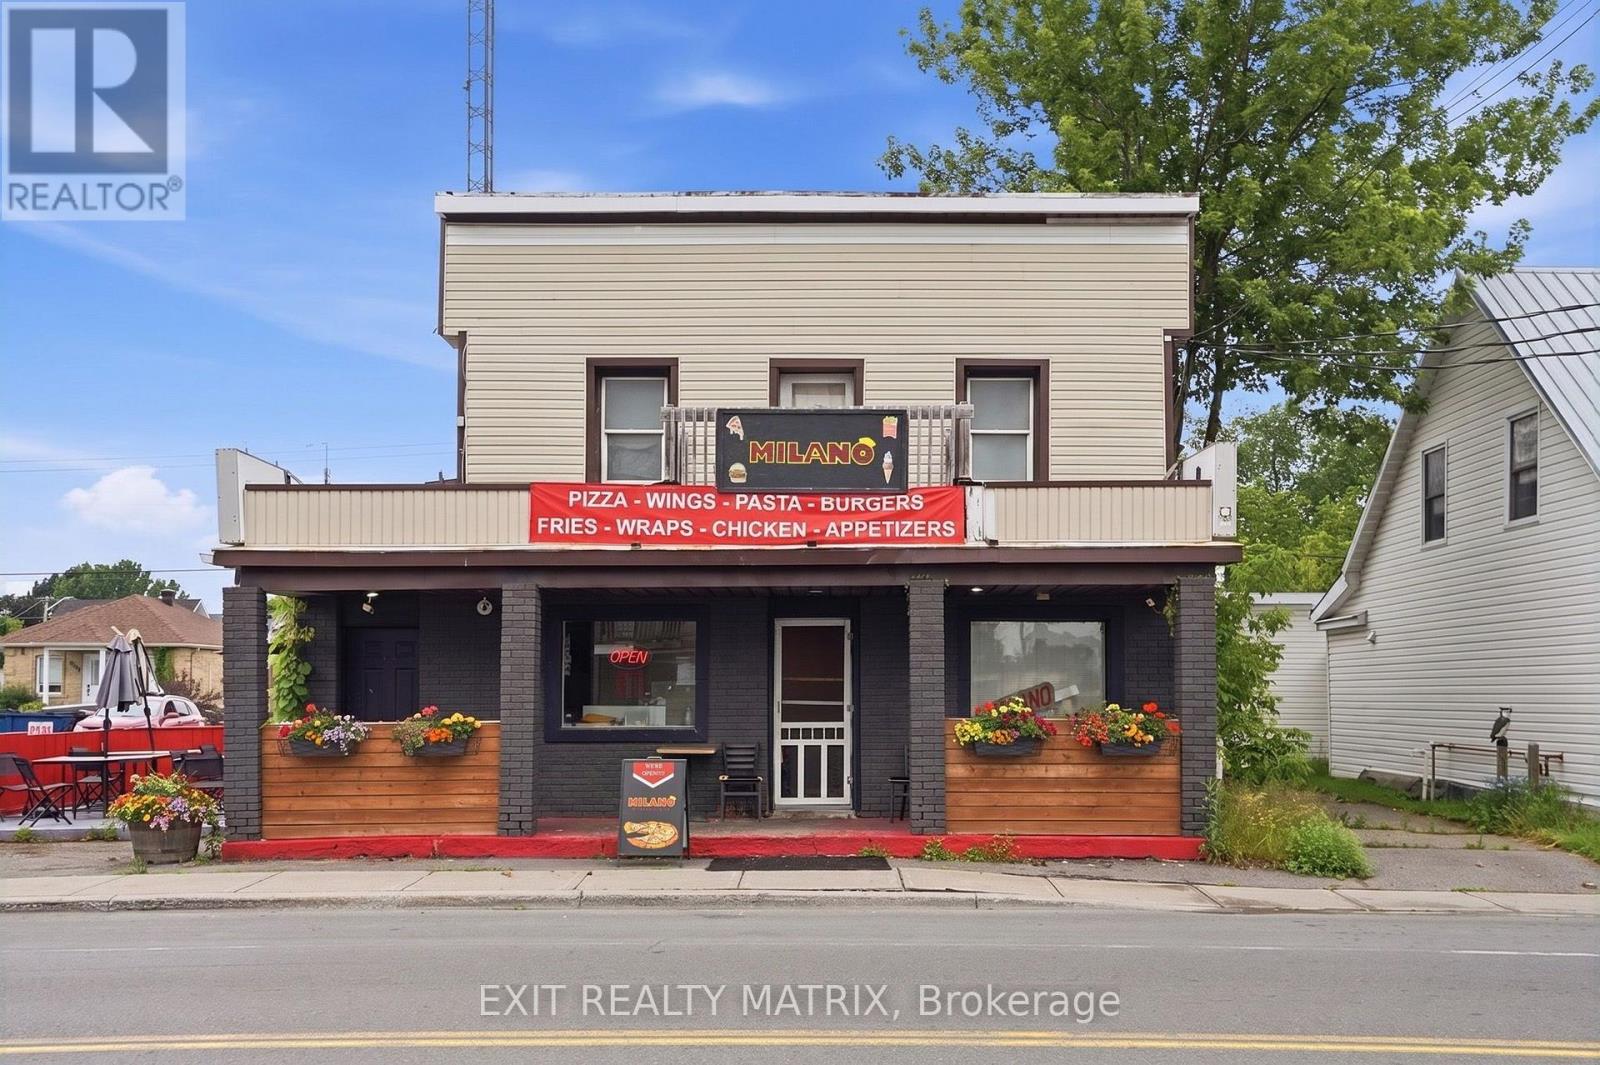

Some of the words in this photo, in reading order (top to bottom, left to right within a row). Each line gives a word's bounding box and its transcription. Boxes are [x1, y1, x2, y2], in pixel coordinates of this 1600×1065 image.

[749, 440, 875, 466] MILANO
[568, 491, 628, 508] PIZZA
[645, 492, 716, 510] WINGS
[735, 494, 802, 511] PASTA
[820, 494, 924, 512] BURGERS
[537, 518, 598, 535] FRIES
[616, 519, 694, 537] WRAPS
[712, 520, 806, 538] CHICKEN
[825, 520, 956, 538] APPETIZERS
[609, 650, 649, 664] OPEN
[627, 796, 676, 808] MILANO
